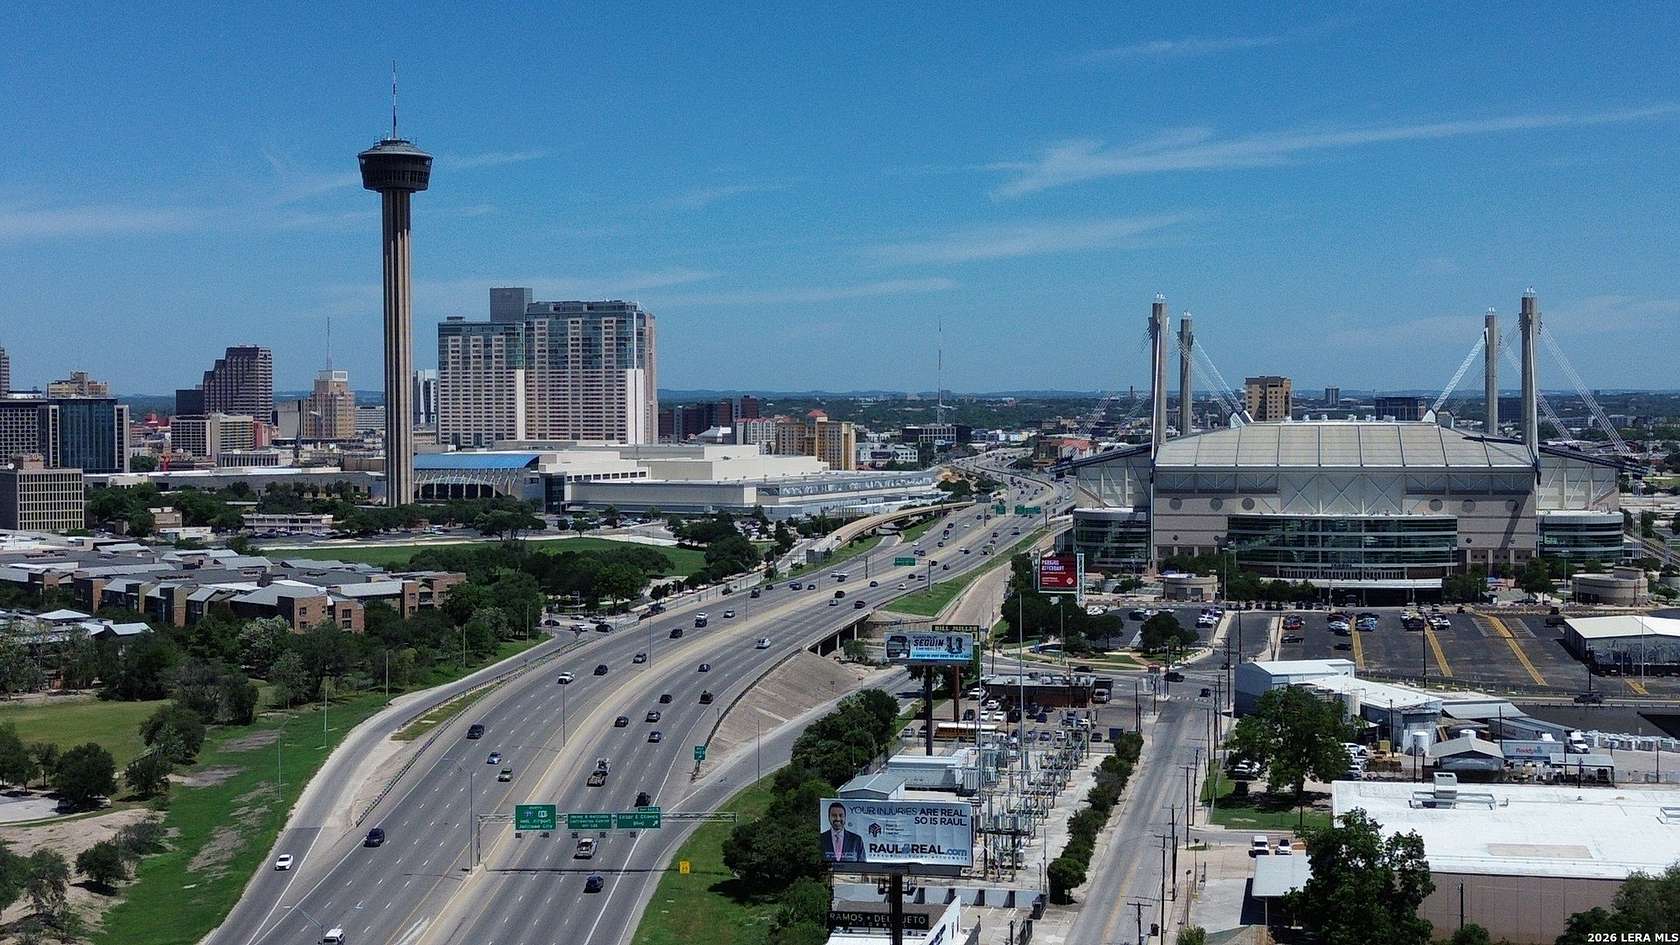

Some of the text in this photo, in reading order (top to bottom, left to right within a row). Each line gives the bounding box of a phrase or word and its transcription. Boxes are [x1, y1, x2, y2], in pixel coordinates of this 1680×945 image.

[913, 639, 944, 647] SEGUIN
[849, 807, 876, 815] YOUR
[877, 807, 917, 816] INJURIES
[919, 808, 938, 816] ARE
[914, 817, 928, 825] SO
[829, 912, 863, 922] RAMOS
